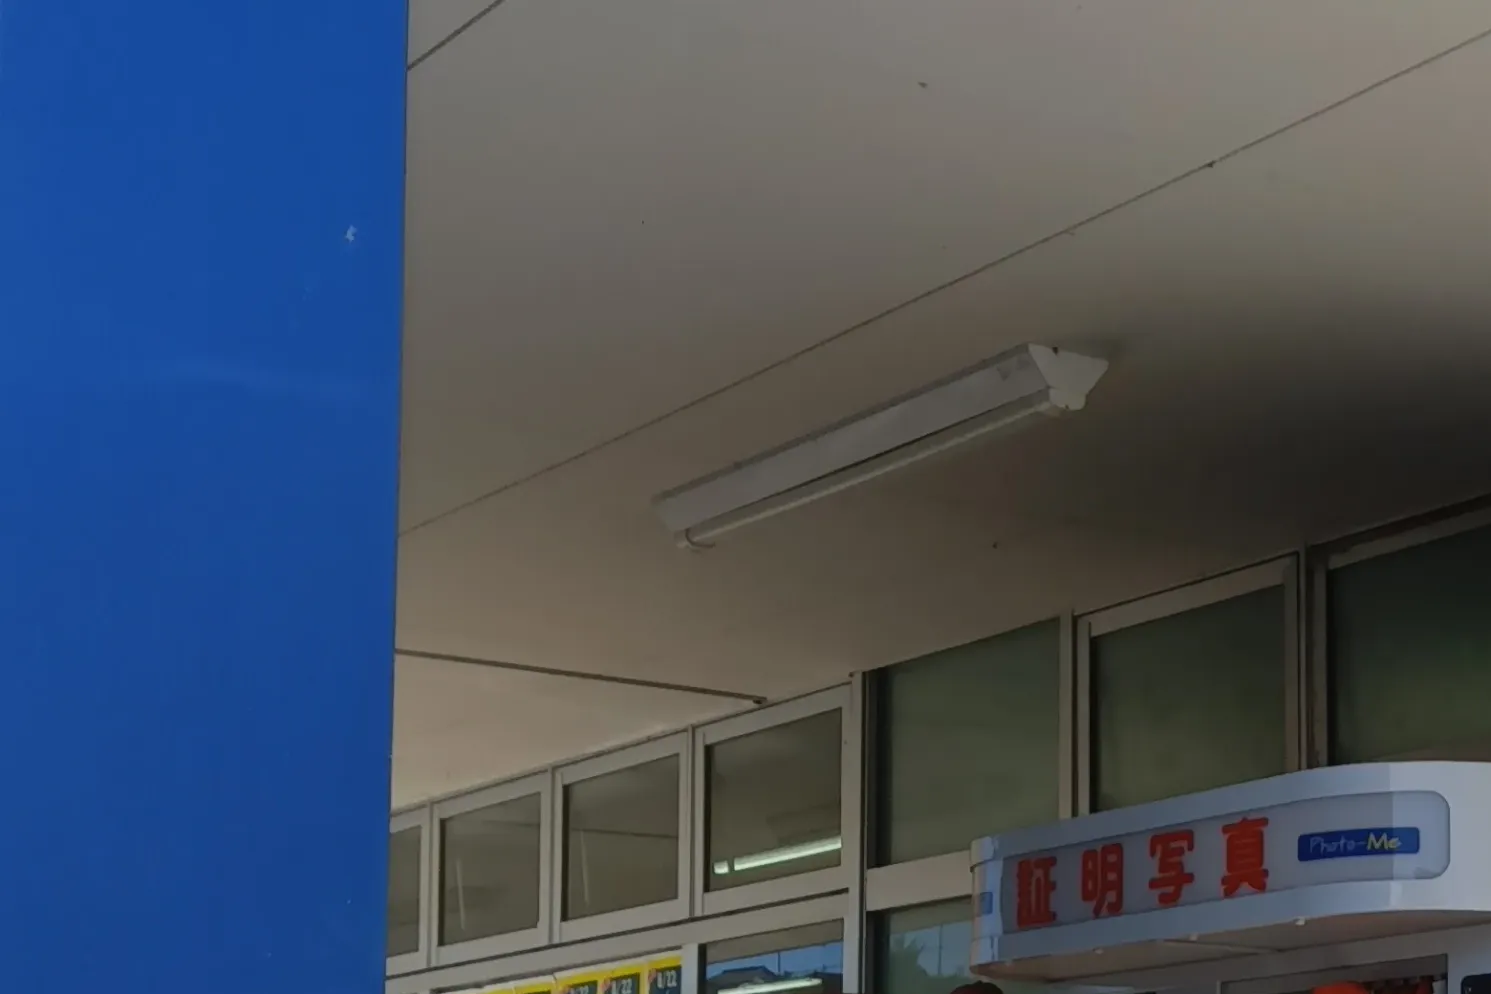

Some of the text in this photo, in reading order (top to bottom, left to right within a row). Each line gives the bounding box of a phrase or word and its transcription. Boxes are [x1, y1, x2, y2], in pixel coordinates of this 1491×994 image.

[1015, 816, 1270, 928] 証明写真
[1309, 831, 1403, 857] Photo-Me
